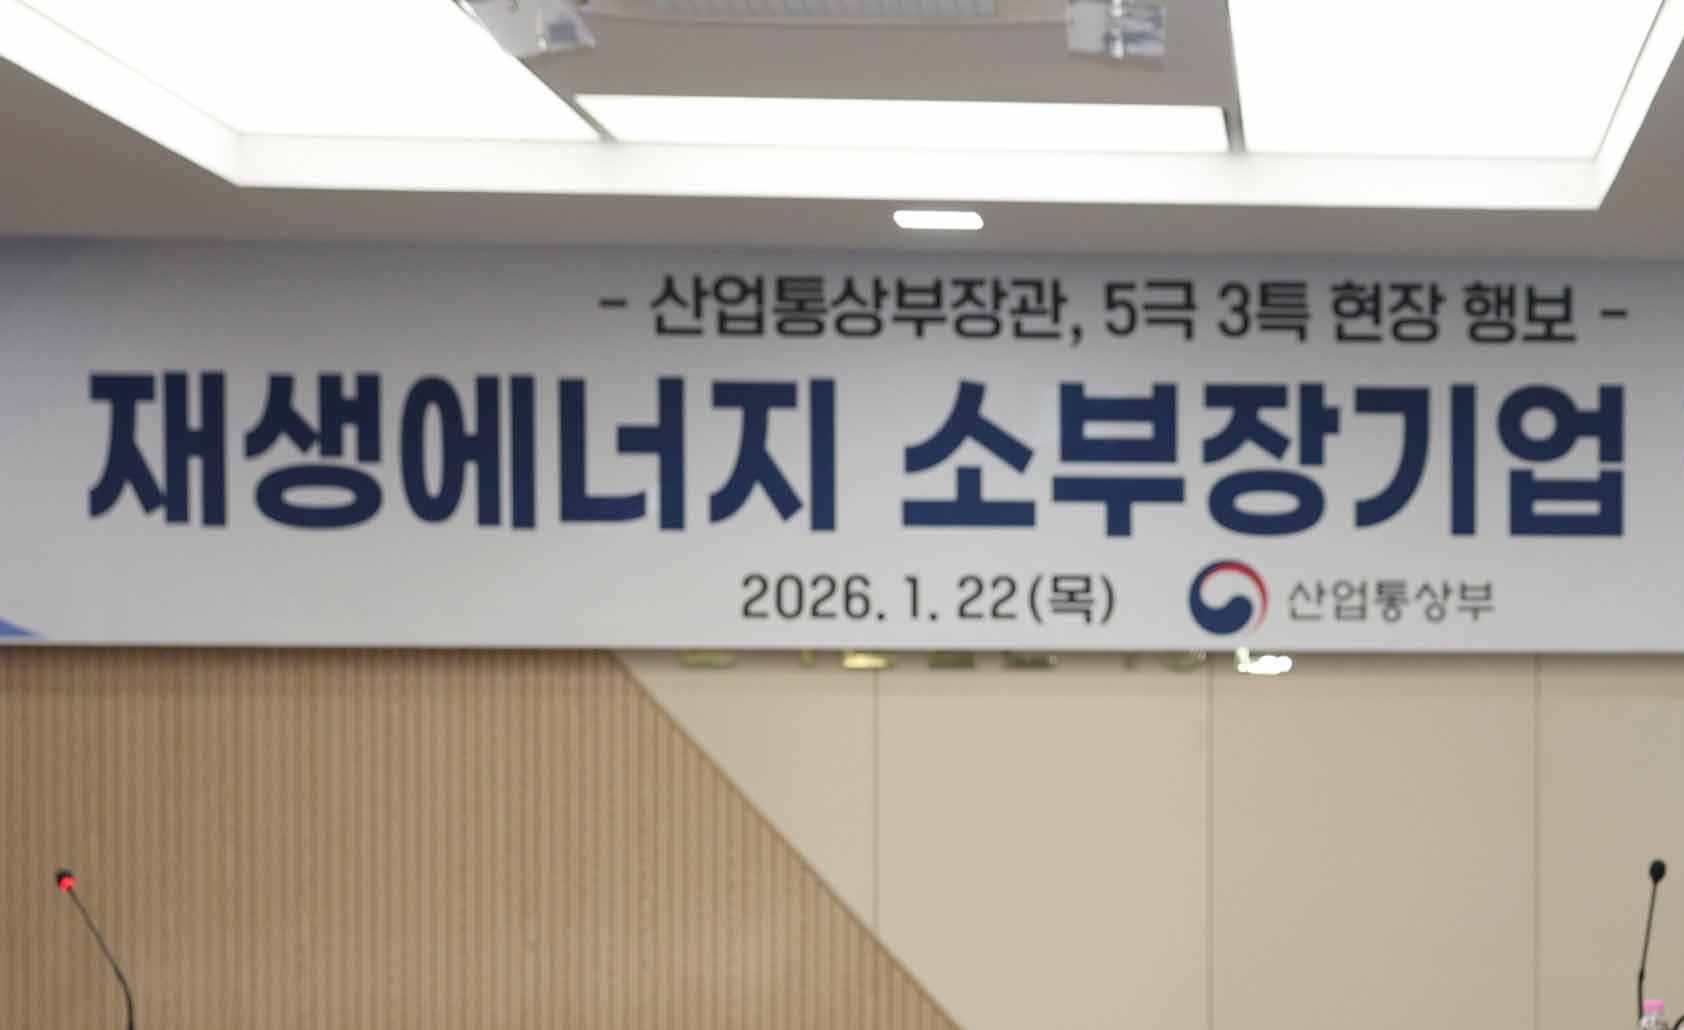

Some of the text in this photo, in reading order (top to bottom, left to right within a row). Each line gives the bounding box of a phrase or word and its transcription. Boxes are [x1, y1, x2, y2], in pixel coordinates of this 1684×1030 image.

[650, 273, 1084, 347] 산업통상부장관,
[1103, 278, 1198, 341] 5극
[1217, 280, 1311, 342] 3특
[1330, 280, 1446, 344] 현장
[1461, 280, 1577, 344] 행보
[88, 369, 836, 532] 재생에너지
[902, 379, 1626, 538] 소부장기업
[1288, 579, 1494, 624] 산업통상부
